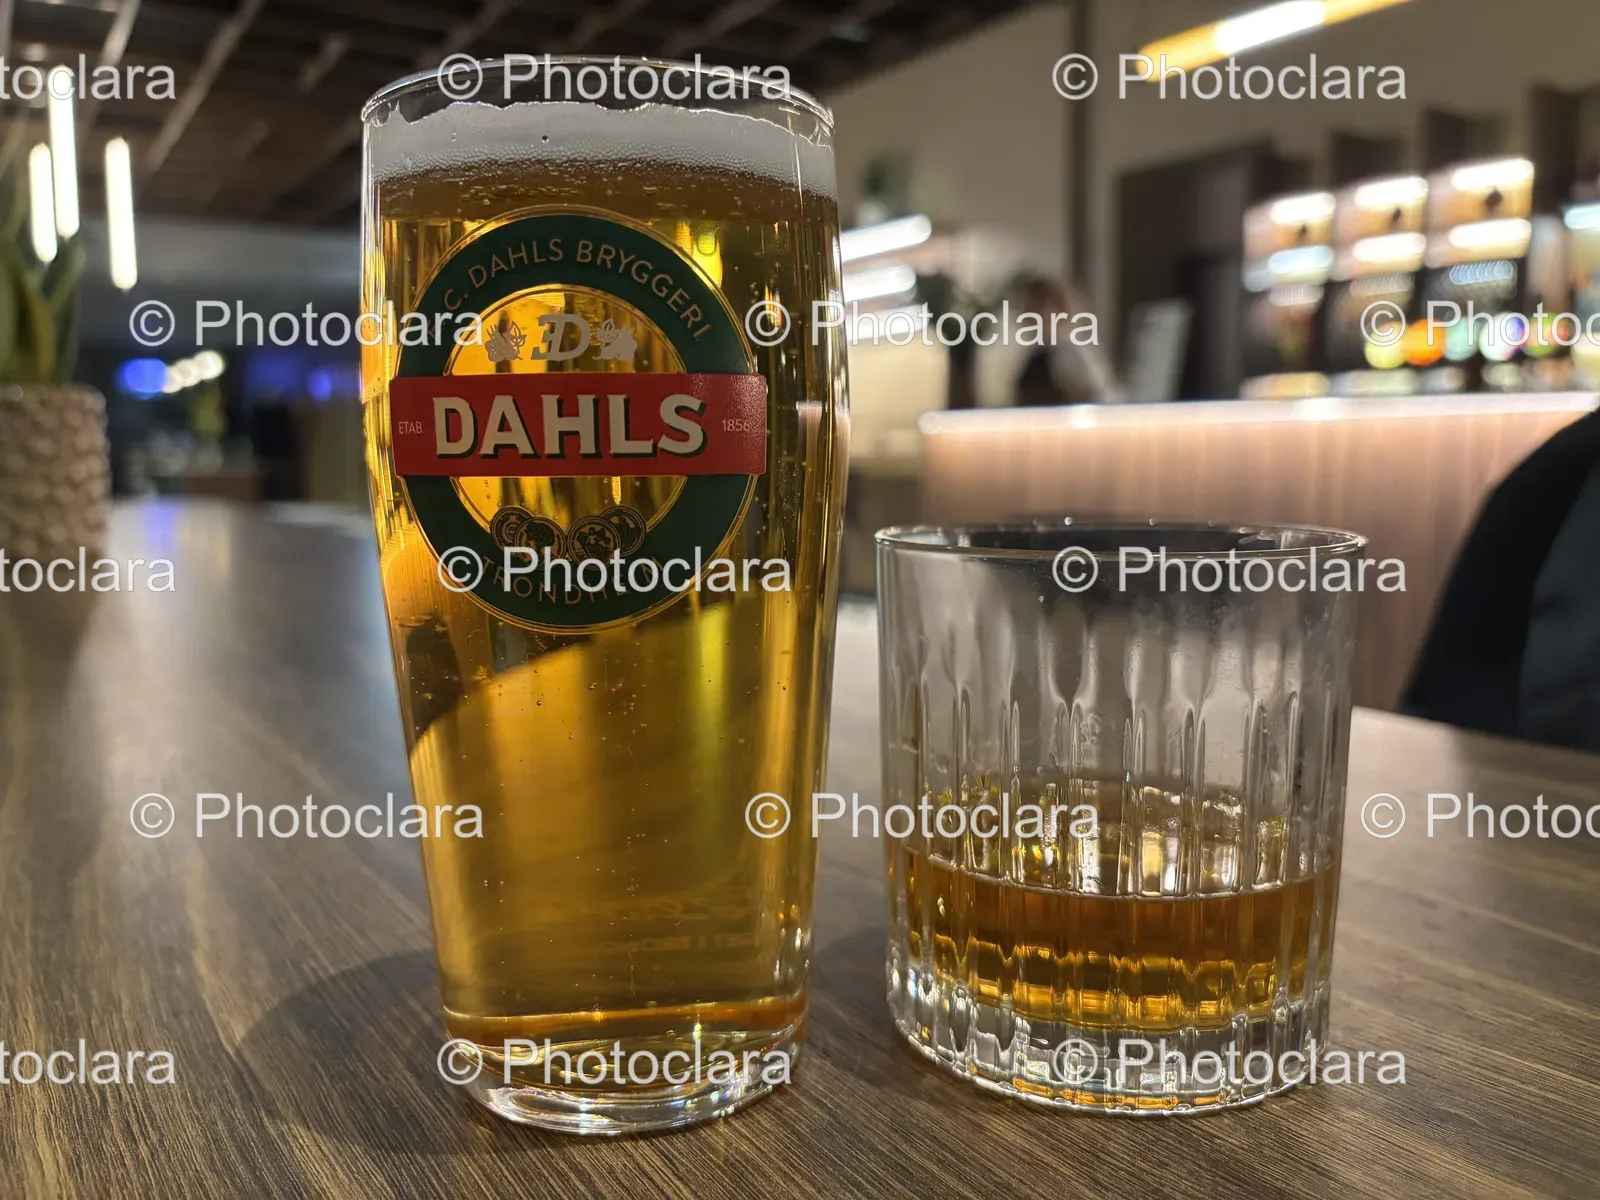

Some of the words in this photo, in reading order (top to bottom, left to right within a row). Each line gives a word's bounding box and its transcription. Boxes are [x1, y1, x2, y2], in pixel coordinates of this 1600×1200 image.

[468, 237, 564, 288] DAHLS
[576, 240, 711, 338] BRYGGERI
[398, 421, 425, 434] ETAB.
[432, 393, 707, 459] DAHLS
[721, 418, 751, 432] 1856
